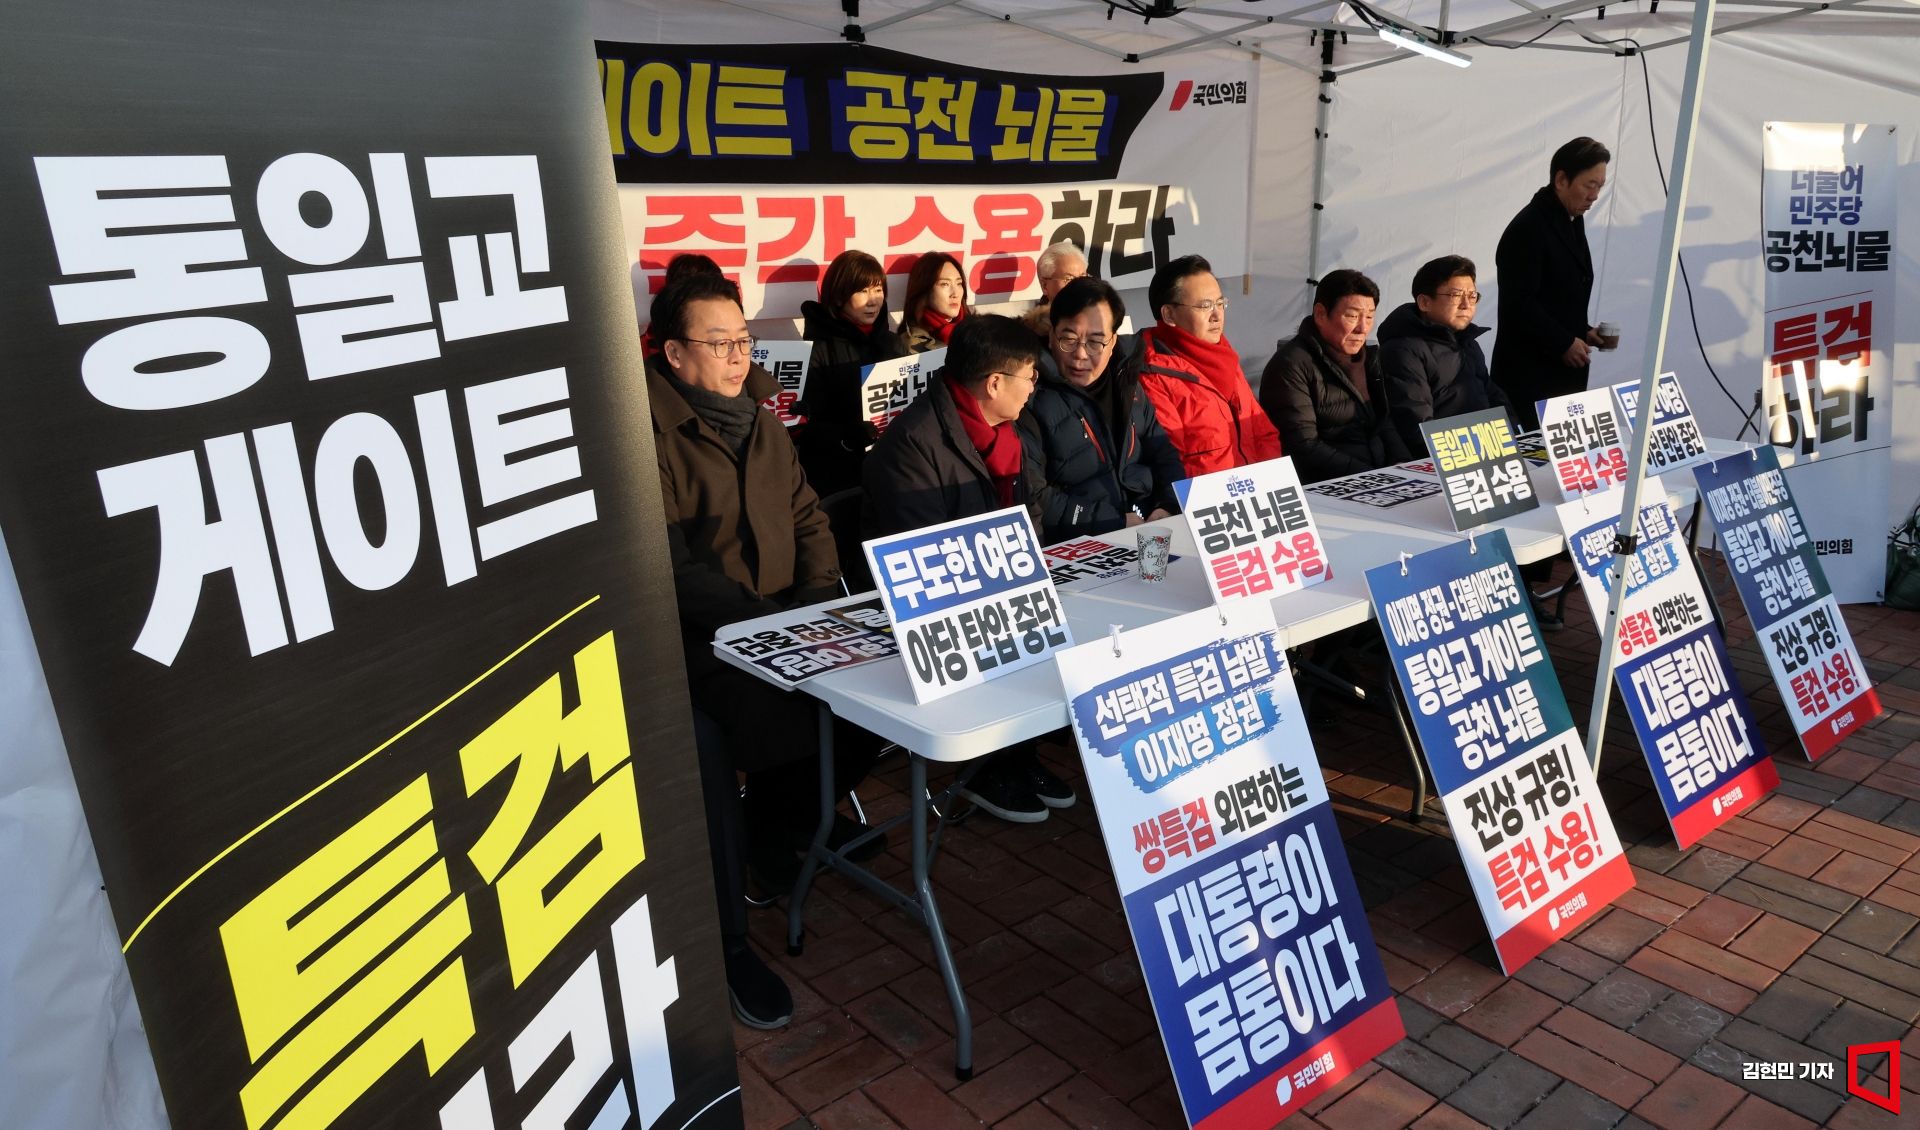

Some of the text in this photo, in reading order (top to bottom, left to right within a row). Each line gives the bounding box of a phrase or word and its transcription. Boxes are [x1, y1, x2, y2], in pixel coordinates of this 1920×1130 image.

[597, 58, 1105, 162] 이트 공천 뇌물
[1192, 80, 1247, 106] 국민의힘
[1789, 195, 1863, 226] 민주당
[1790, 164, 1864, 195] 더불어
[639, 195, 856, 302] 즉각
[33, 152, 569, 411] 통일교
[752, 349, 770, 360] 주당
[898, 362, 921, 376] 민주당
[1770, 300, 1873, 380] 특검
[867, 378, 909, 414] 공천
[1567, 402, 1585, 417] 민주당
[1656, 381, 1685, 415] 여당
[1430, 418, 1517, 472] 통일교 게이트
[1546, 419, 1583, 460] 공천
[1583, 411, 1620, 449] 뇌물
[1657, 425, 1686, 463] 탄압
[1676, 419, 1705, 457] 중단
[1226, 478, 1256, 498] 민주당
[1445, 459, 1532, 515] 특검 수용
[1557, 456, 1599, 494] 특검
[1594, 446, 1629, 486] 수용
[96, 366, 599, 667] 게이트
[1192, 485, 1310, 555] 공천 뇌물
[1640, 504, 1670, 541] 남발
[1706, 486, 1736, 524] 이재명
[883, 522, 1036, 609] 무도한 여당
[1210, 531, 1324, 598] 특검 수용
[1641, 541, 1673, 577] 정권
[1722, 506, 1808, 574] 통일교 게이트
[1808, 538, 1854, 555] 민의힘
[1652, 591, 1703, 638] 외면하는
[1753, 555, 1817, 617] 공천 뇌물
[724, 630, 802, 659] 중단
[906, 587, 1067, 687] 야당 탄압 중단
[1384, 593, 1431, 647] 이재명
[1770, 604, 1842, 675] 진상 규명!
[770, 646, 853, 677] 여당
[1095, 635, 1272, 741] 선택적 특검 남발
[1403, 612, 1544, 716] 통일교 게이트
[1630, 633, 1730, 731] 대통령이
[1789, 648, 1861, 718] 특검 수용!
[1134, 688, 1266, 783] 이재명 정권
[1447, 679, 1548, 771] 공천 뇌물
[1655, 697, 1755, 803] 몸통이다
[1132, 762, 1309, 874] 쌍특검 외면하는
[1463, 743, 1581, 853] 진상 규명!
[219, 629, 646, 1130] 특검
[1487, 802, 1604, 911] 특검 수용!
[1153, 822, 1339, 988] 대통령이
[1558, 891, 1588, 920] 국민의힘
[439, 893, 680, 1130] 라
[1184, 915, 1367, 1096] 몸통이다
[1293, 1050, 1336, 1091] 국민의힘
